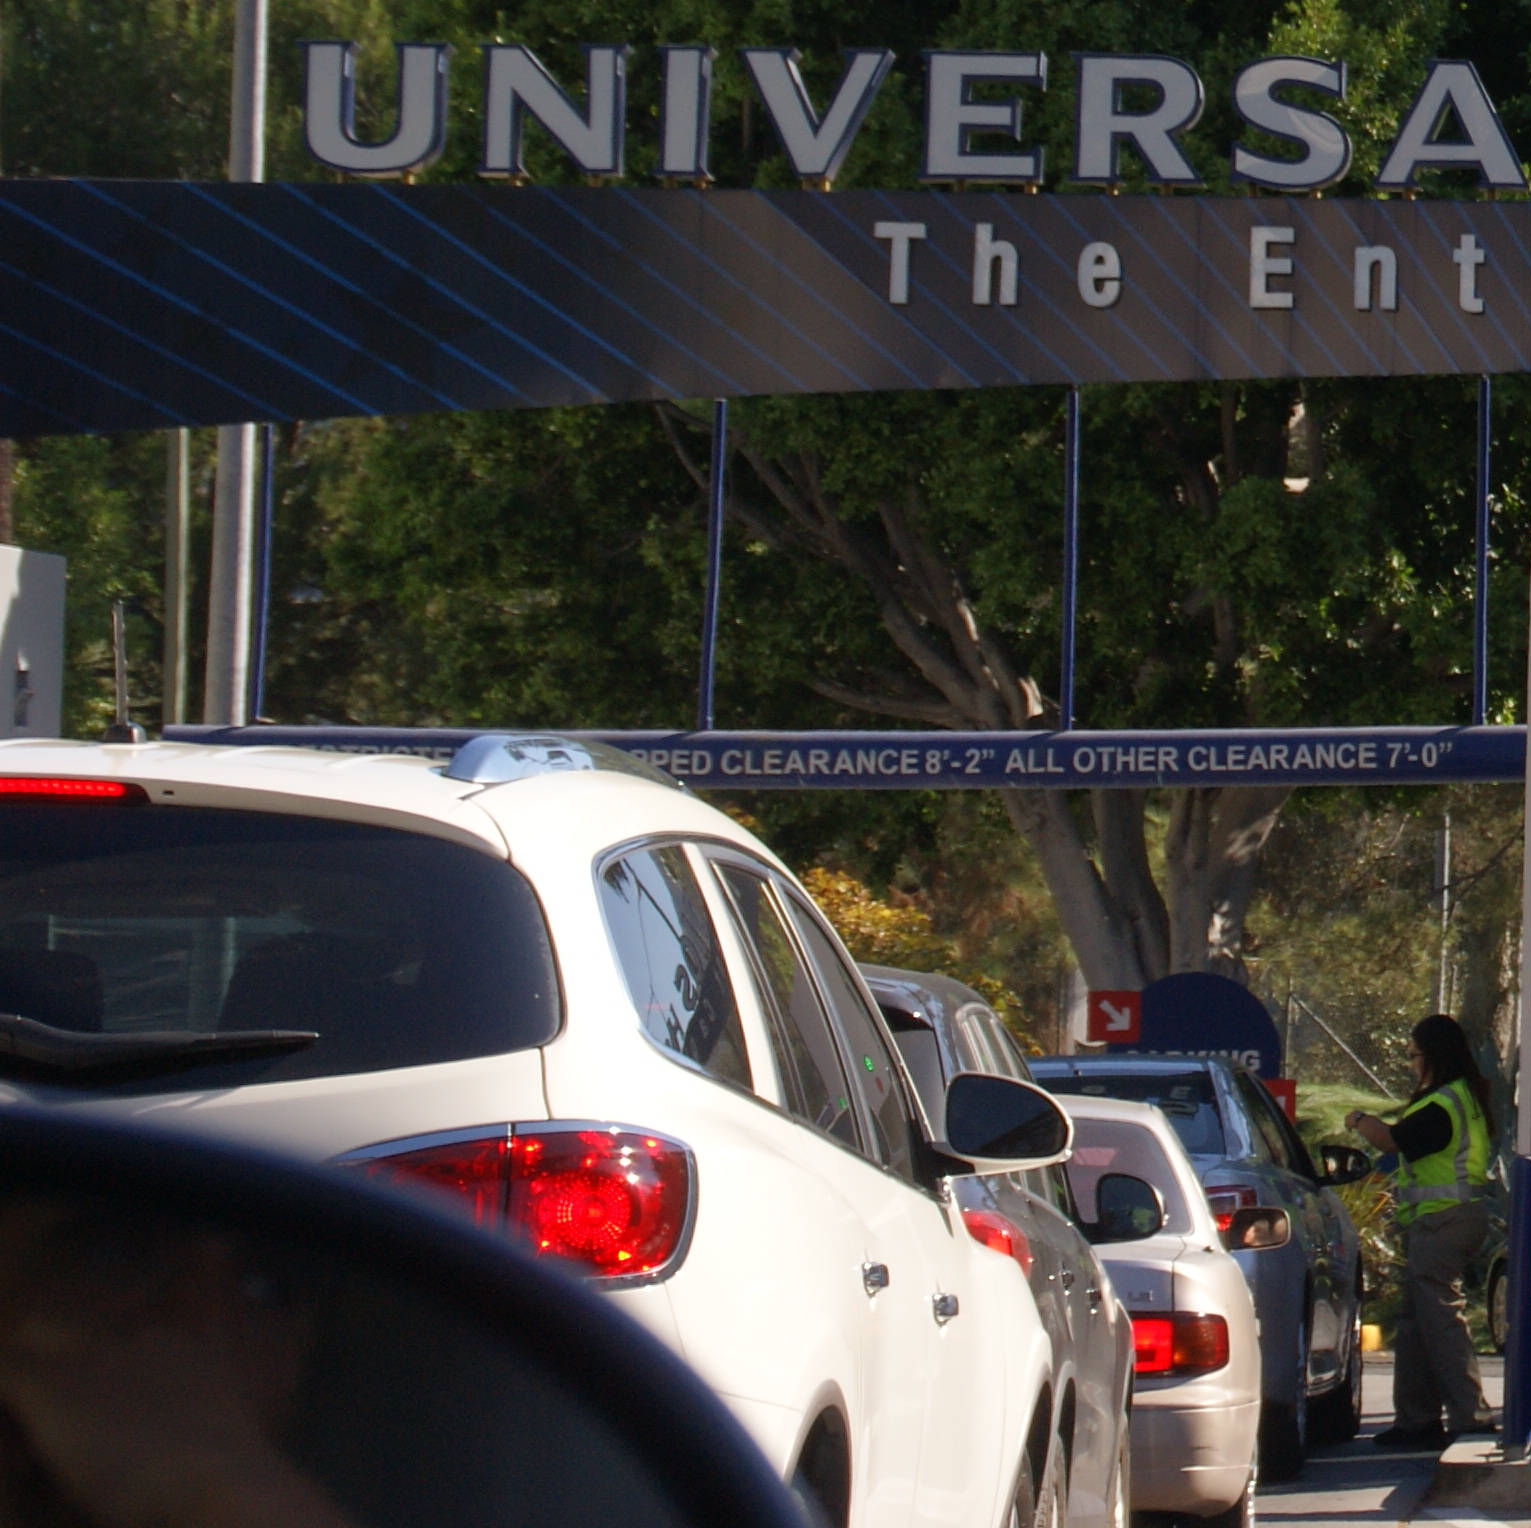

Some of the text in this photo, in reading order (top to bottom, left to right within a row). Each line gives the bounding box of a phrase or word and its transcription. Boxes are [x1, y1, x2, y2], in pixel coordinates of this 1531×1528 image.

[874, 220, 1122, 310] The
[718, 748, 918, 775] CLEARANCE
[1004, 747, 1063, 773] ALL
[1073, 745, 1179, 773] OTHER
[1187, 742, 1378, 771] CLEARANCE
